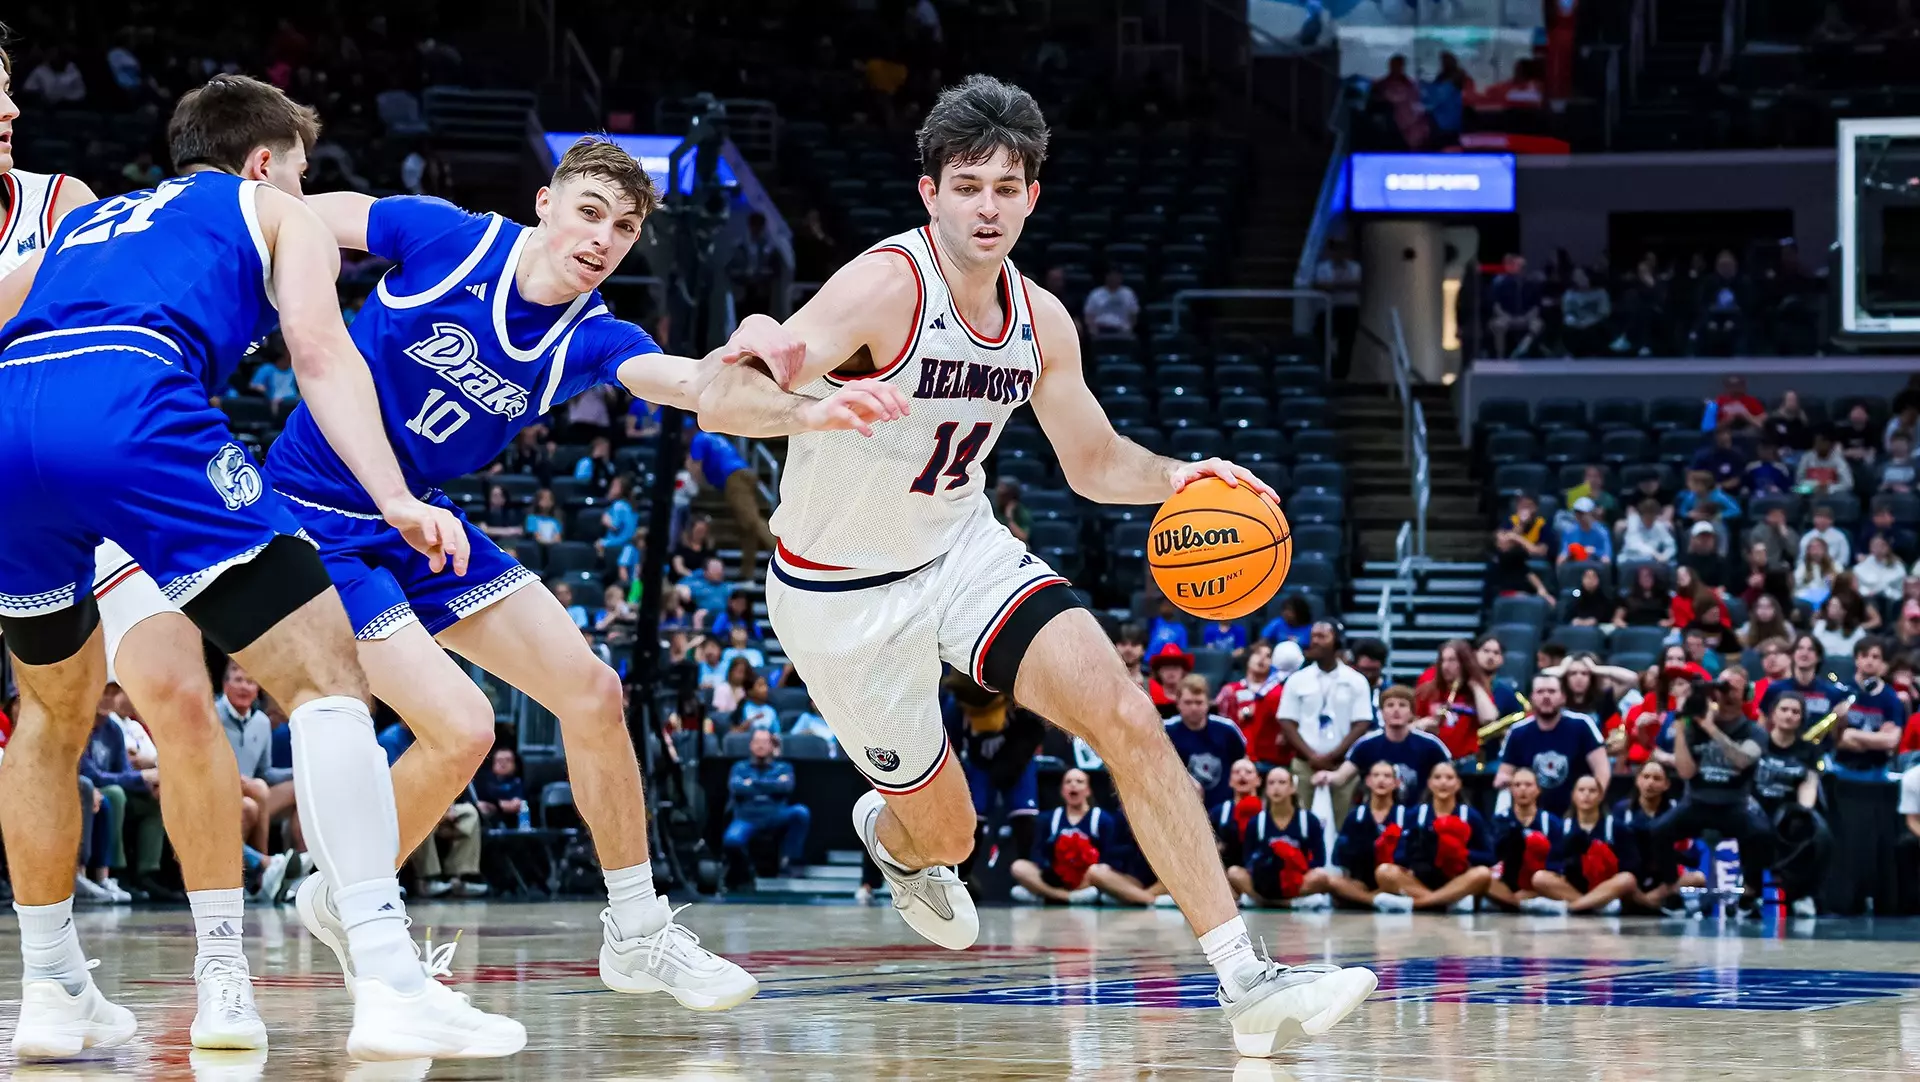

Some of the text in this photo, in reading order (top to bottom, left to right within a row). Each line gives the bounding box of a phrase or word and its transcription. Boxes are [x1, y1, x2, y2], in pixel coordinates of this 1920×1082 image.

[403, 322, 530, 422] Drake
[913, 357, 1034, 405] BELMONT
[405, 388, 471, 444] 10
[909, 421, 993, 496] 14
[1153, 523, 1241, 557] Wilson
[1226, 567, 1244, 581] NXT
